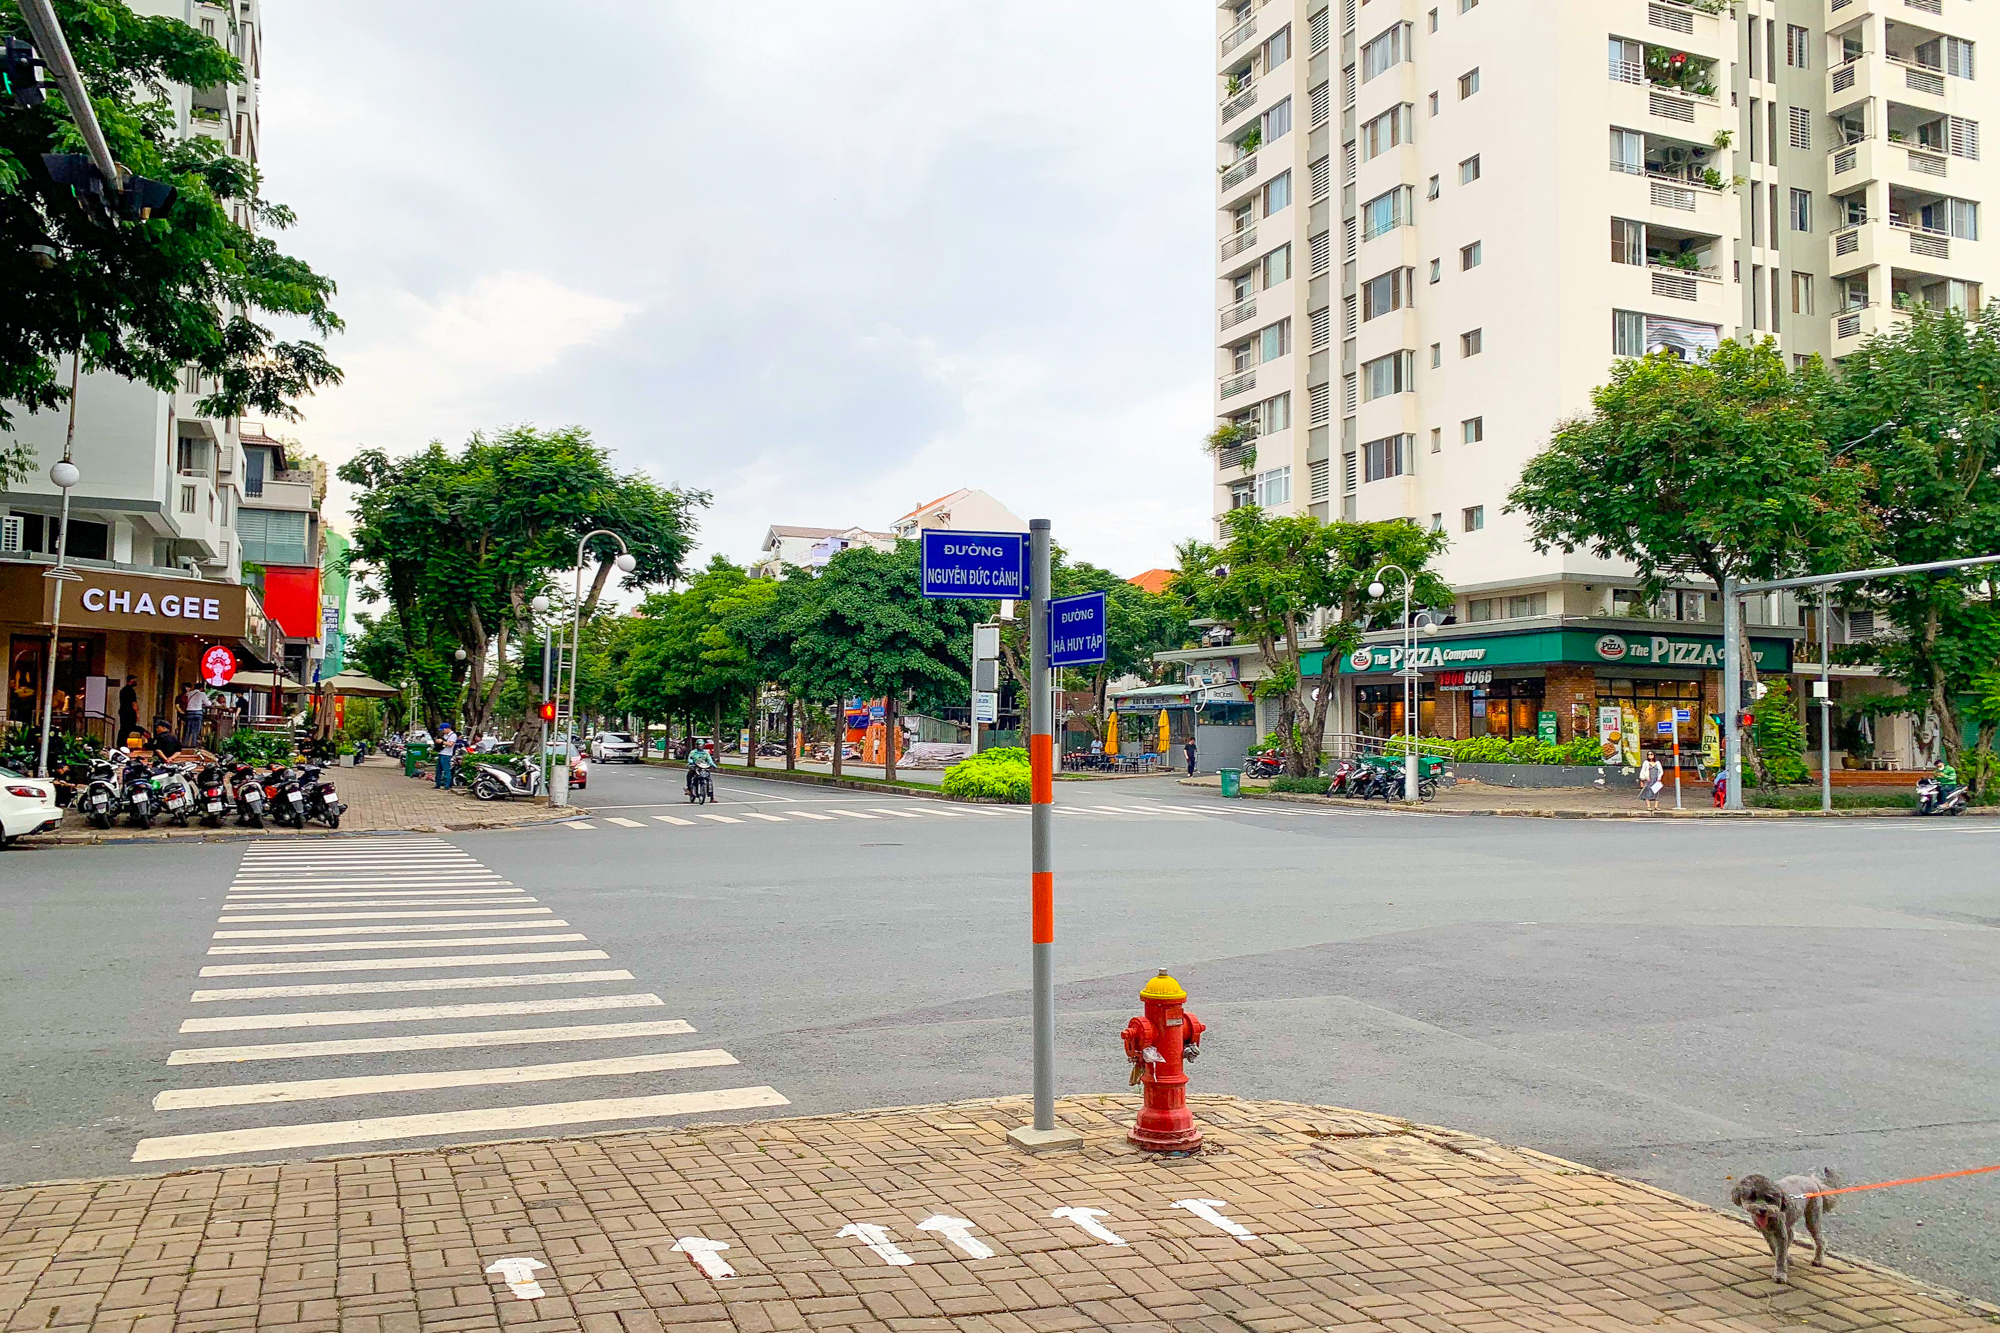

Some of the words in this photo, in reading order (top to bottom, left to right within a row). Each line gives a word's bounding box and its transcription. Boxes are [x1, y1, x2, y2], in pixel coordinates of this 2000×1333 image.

[943, 544, 1004, 557] ĐƯỜNG
[928, 565, 967, 585] NGUYỄN
[969, 566, 990, 586] ĐỨC
[992, 567, 1018, 587] CẢNH
[82, 588, 220, 620] CHAGEE
[1061, 608, 1094, 623] ĐƯỜNG
[1053, 636, 1066, 654] HÀ
[1067, 637, 1085, 653] HUY
[1086, 633, 1103, 653] TẬP
[1650, 636, 1718, 665] PIZZA
[1443, 648, 1486, 661] Company
